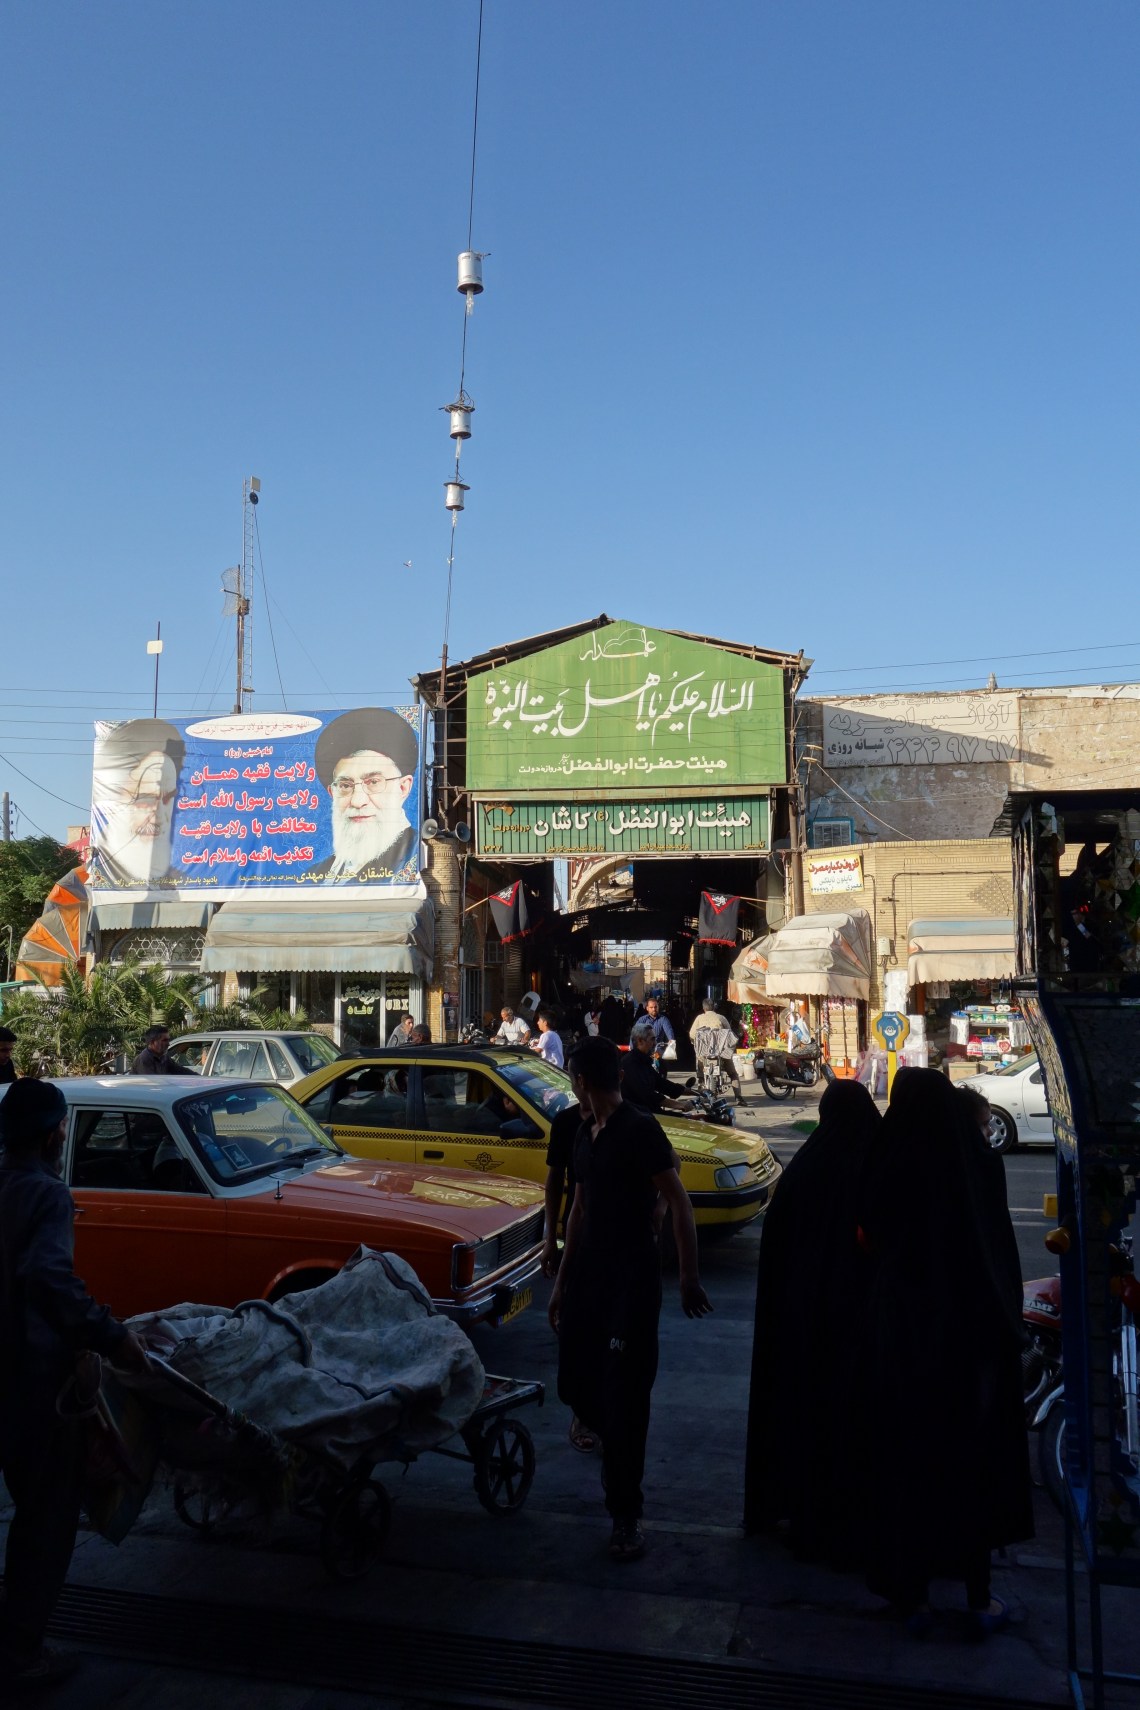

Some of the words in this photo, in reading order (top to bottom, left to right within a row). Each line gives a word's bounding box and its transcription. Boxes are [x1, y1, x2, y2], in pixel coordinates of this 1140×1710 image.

[855, 738, 884, 752] شبانه
[242, 762, 271, 782] فقیه
[274, 761, 316, 782] ولایت
[634, 756, 685, 774] حضرت
[190, 765, 239, 785] همان
[178, 793, 207, 809] است
[211, 788, 234, 807] الله
[235, 791, 273, 810] رسول
[277, 789, 319, 809] ولایت
[180, 820, 211, 839] فقیه
[213, 820, 247, 838] ولایت
[251, 818, 262, 838] با
[266, 817, 316, 834] مخالفت
[533, 805, 592, 836] کاشان
[182, 849, 208, 863] است
[249, 846, 272, 861] ائمه
[273, 846, 313, 864] تکذیب
[295, 871, 323, 883] مهدی
[324, 871, 357, 882] حضرت
[358, 868, 394, 882] عاشقان
